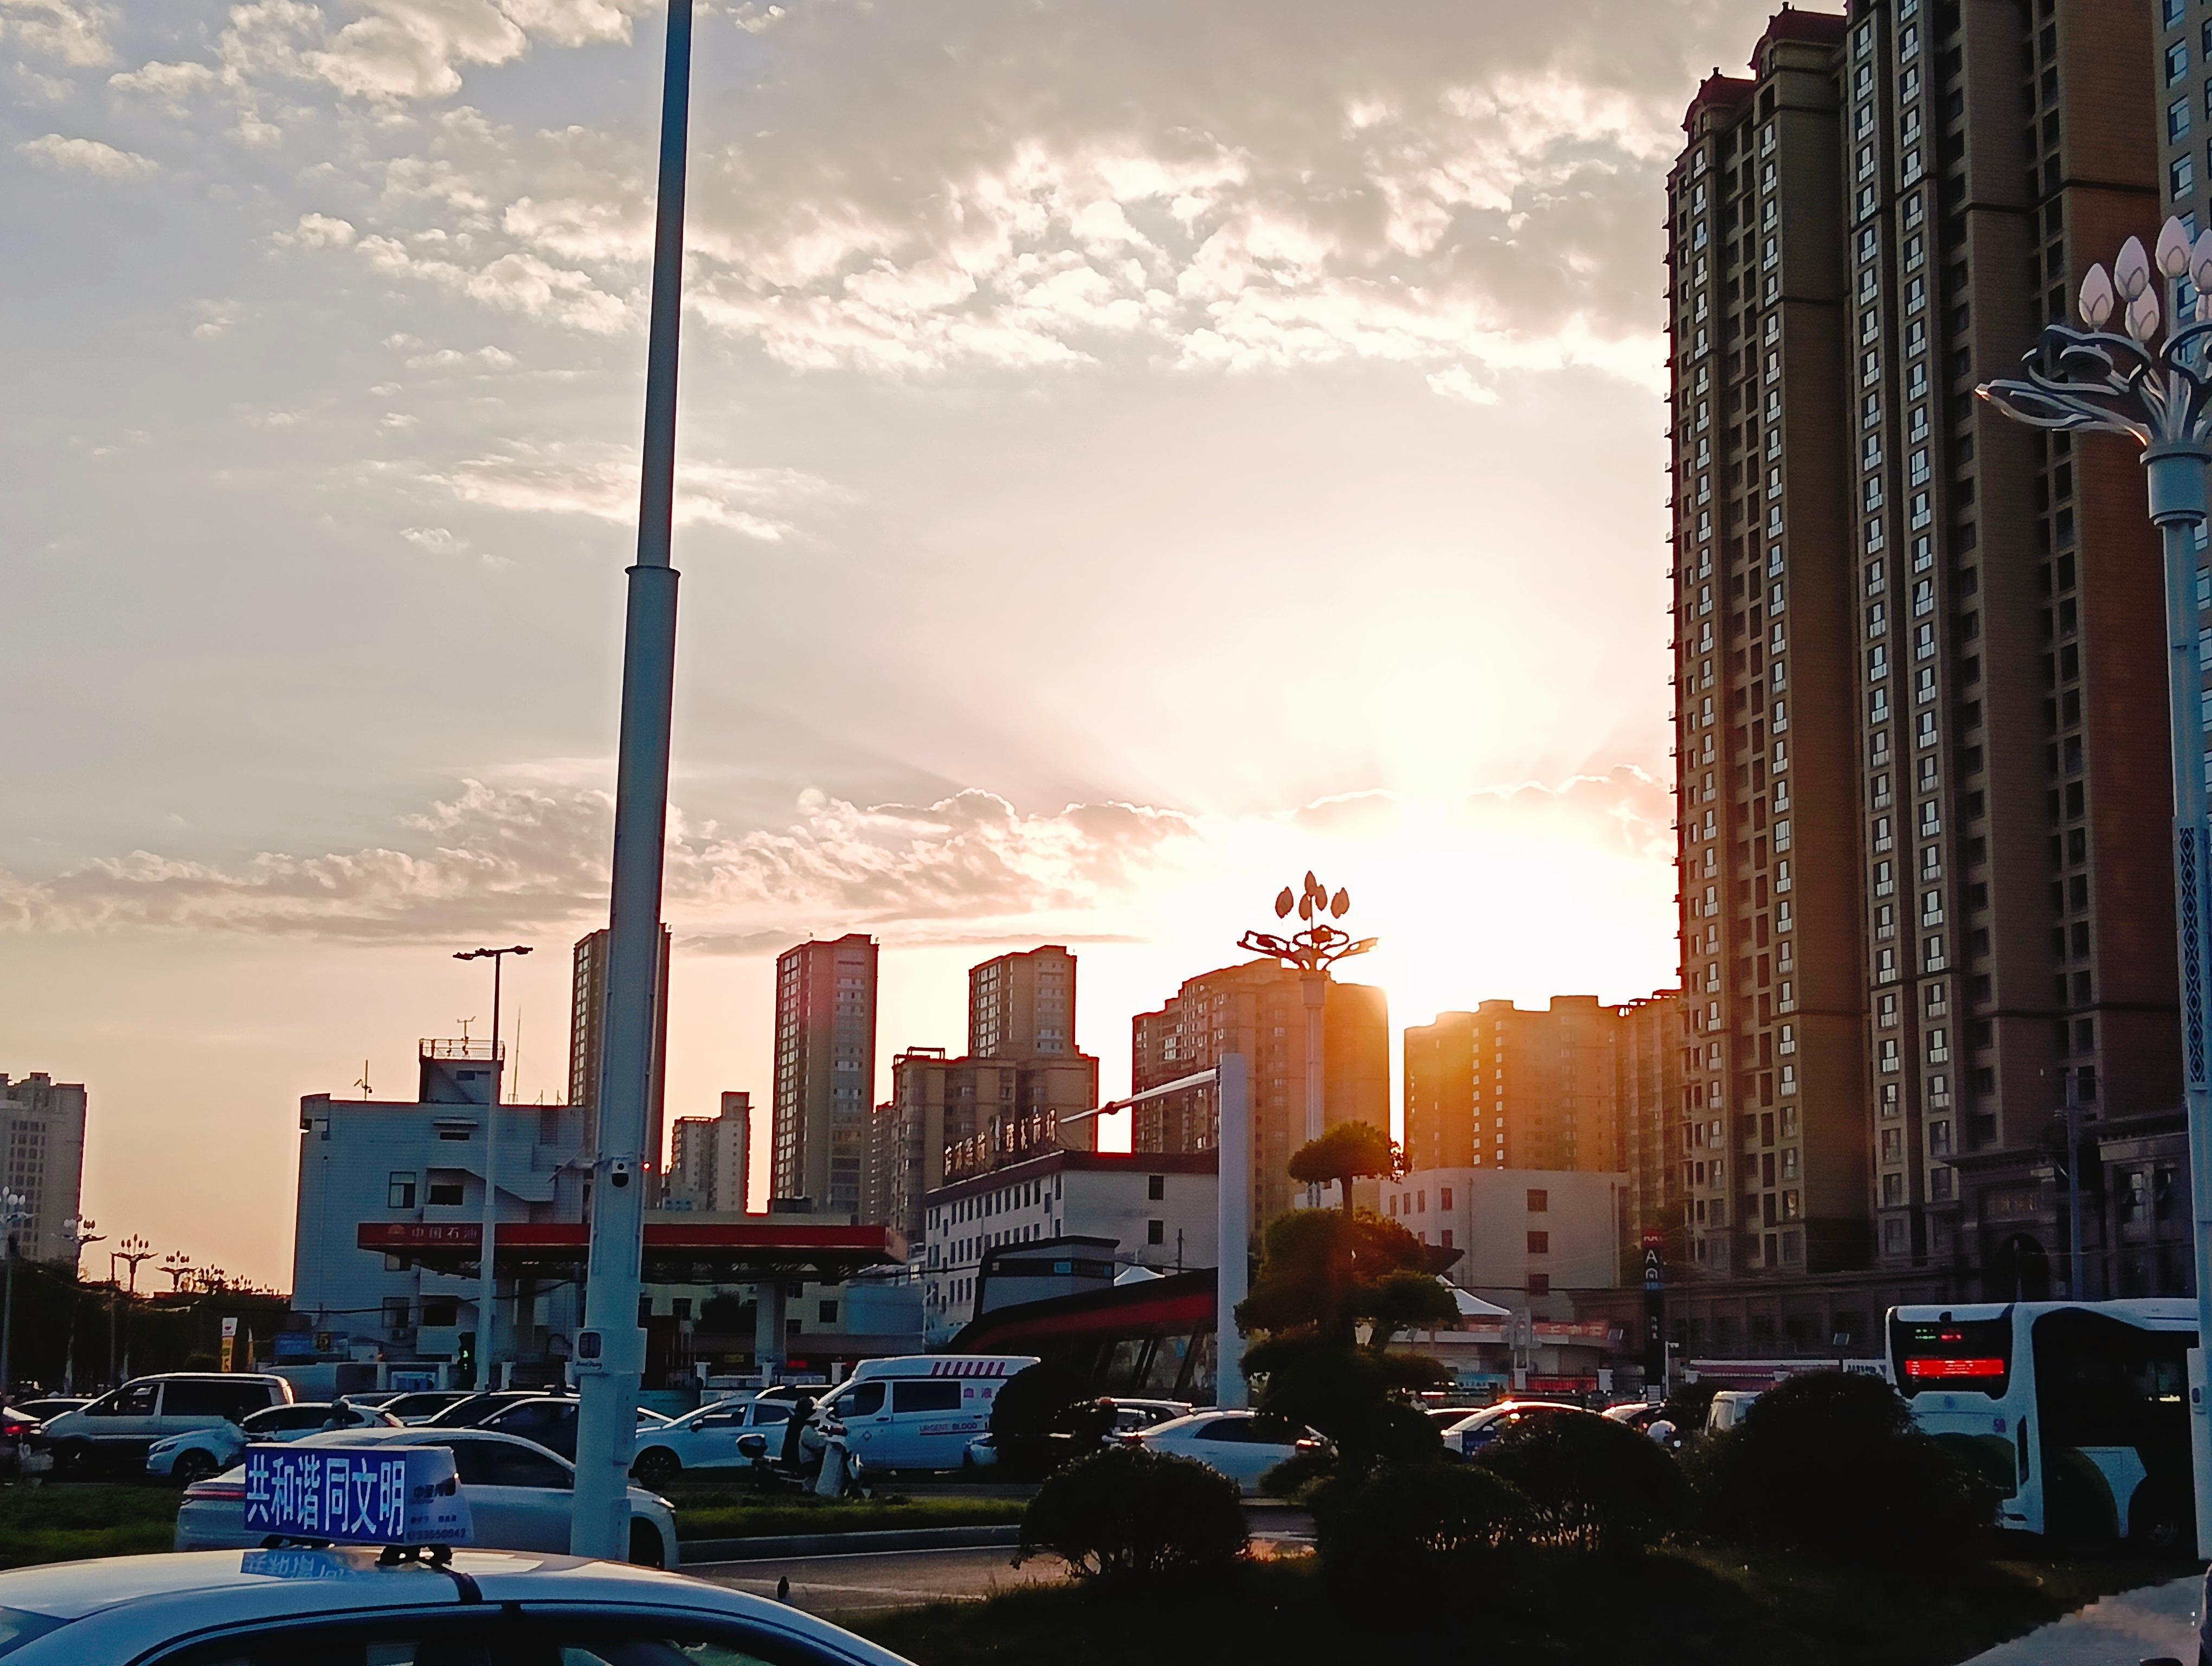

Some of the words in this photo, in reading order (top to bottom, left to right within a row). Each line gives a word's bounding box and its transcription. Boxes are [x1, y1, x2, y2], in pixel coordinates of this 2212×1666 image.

[412, 1227, 477, 1239] 中国石油
[952, 1422, 978, 1430] BLOOD
[247, 1454, 405, 1536] 共和谐同文明
